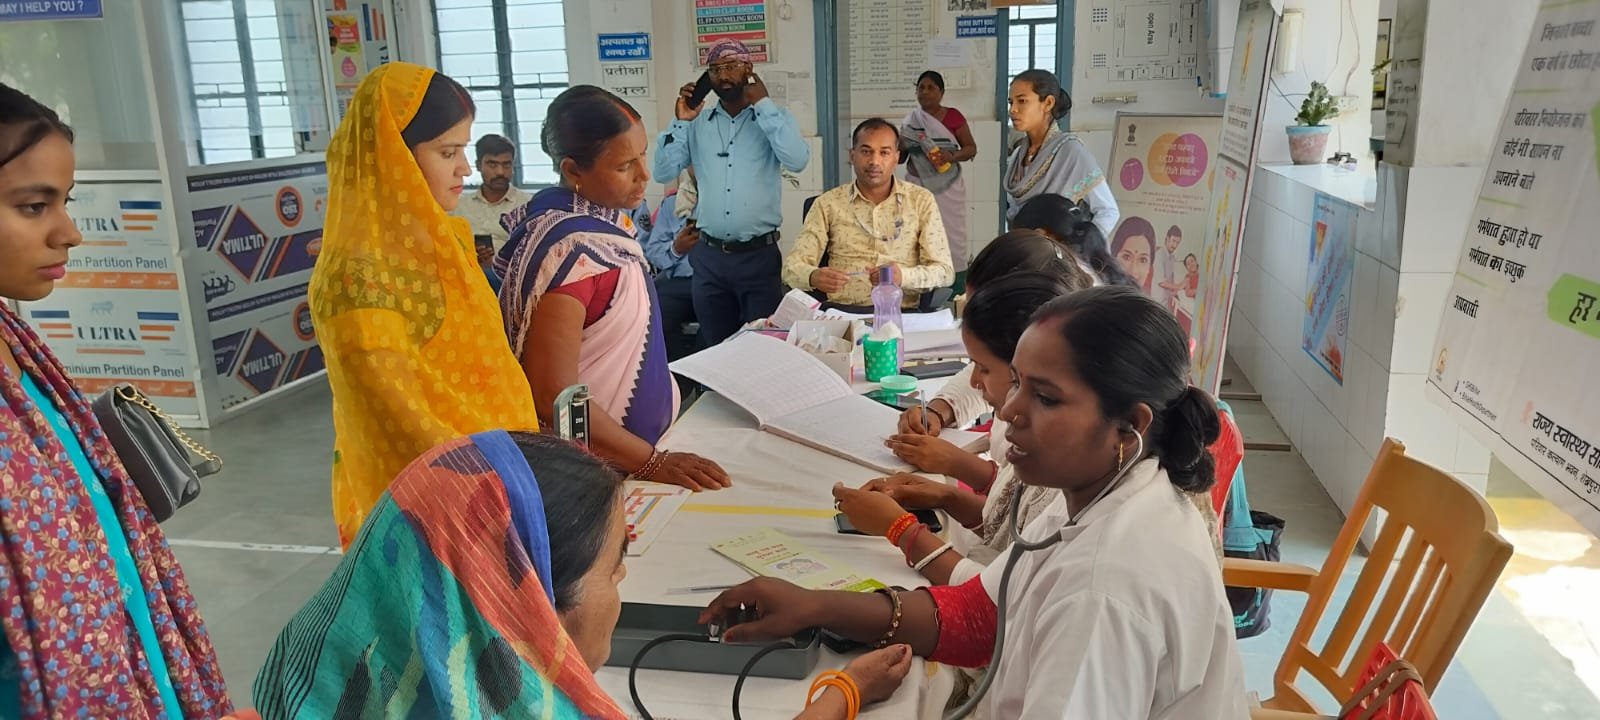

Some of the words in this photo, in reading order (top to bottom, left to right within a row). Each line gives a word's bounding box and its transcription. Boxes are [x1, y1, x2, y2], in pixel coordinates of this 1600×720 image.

[25, 2, 51, 13] HELP
[53, 0, 76, 12] YOU
[72, 217, 119, 231] LTRA
[222, 233, 265, 255] ULTIMA
[1528, 233, 1543, 250] या
[84, 256, 133, 268] Partition
[135, 256, 168, 269] Panel
[1489, 256, 1505, 272] का
[77, 327, 137, 341] ULTRA
[103, 364, 151, 377] Partition
[153, 365, 185, 378] Panel
[242, 352, 283, 377] ULTIMA
[1532, 411, 1555, 437] राज्य
[1553, 424, 1592, 459] स्वास्थ्य
